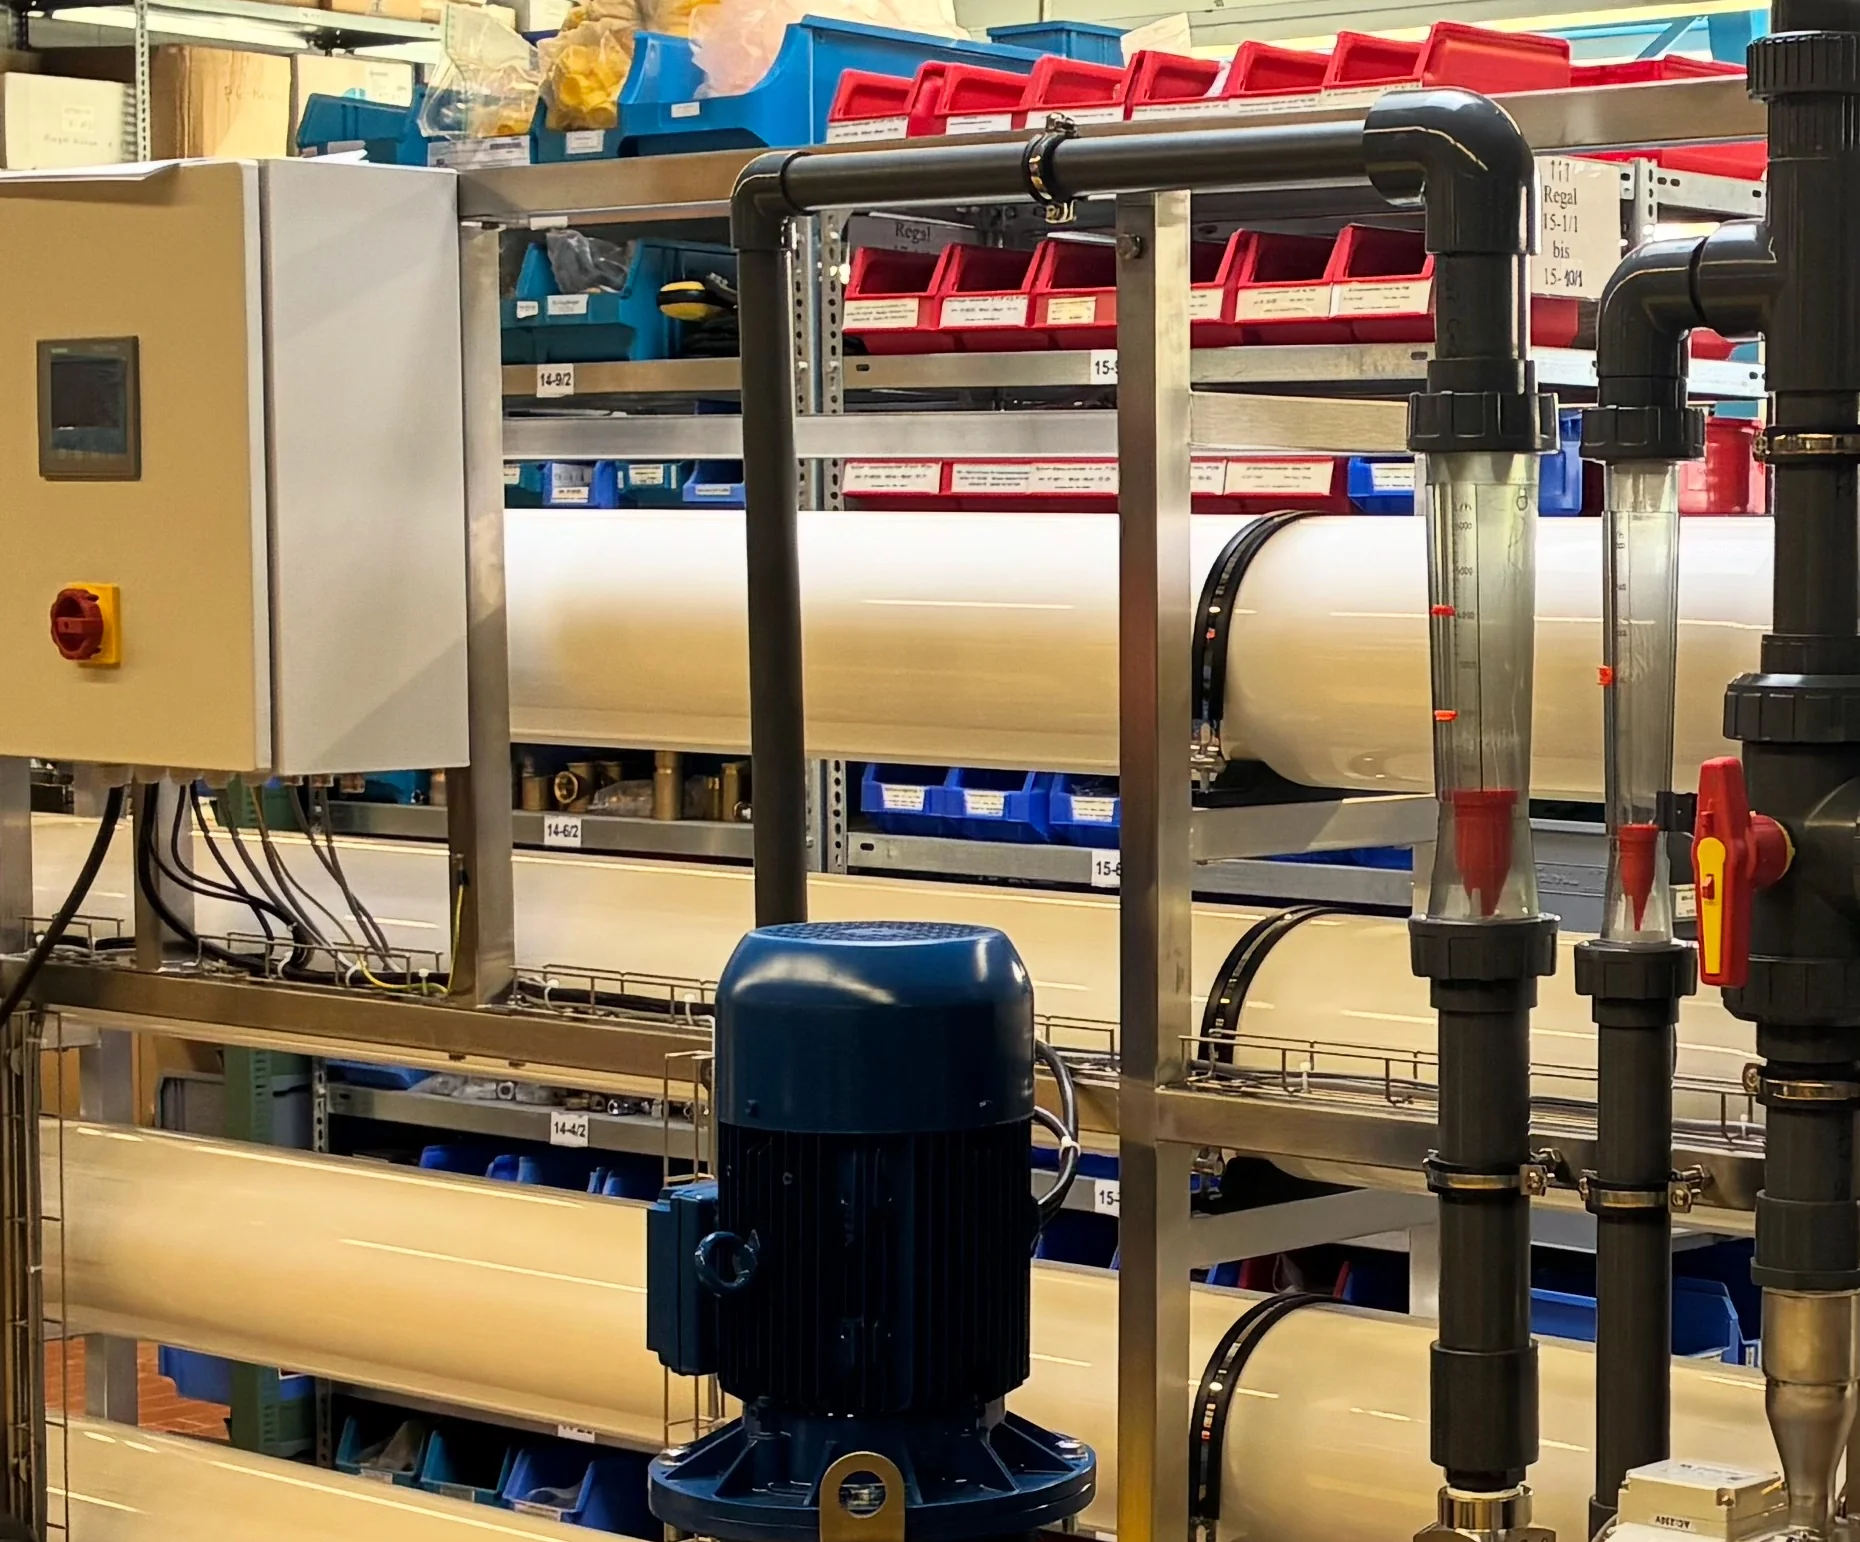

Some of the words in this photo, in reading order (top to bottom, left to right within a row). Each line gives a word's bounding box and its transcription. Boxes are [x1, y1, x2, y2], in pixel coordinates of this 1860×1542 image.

[1544, 185, 1577, 209] Regal
[1544, 213, 1578, 233] 15-1/1
[895, 222, 931, 244] Regal
[1553, 240, 1570, 259] bis
[540, 372, 572, 387] 14-9/2
[547, 823, 579, 838] 14-6/2
[554, 1121, 586, 1138] 14-4/2
